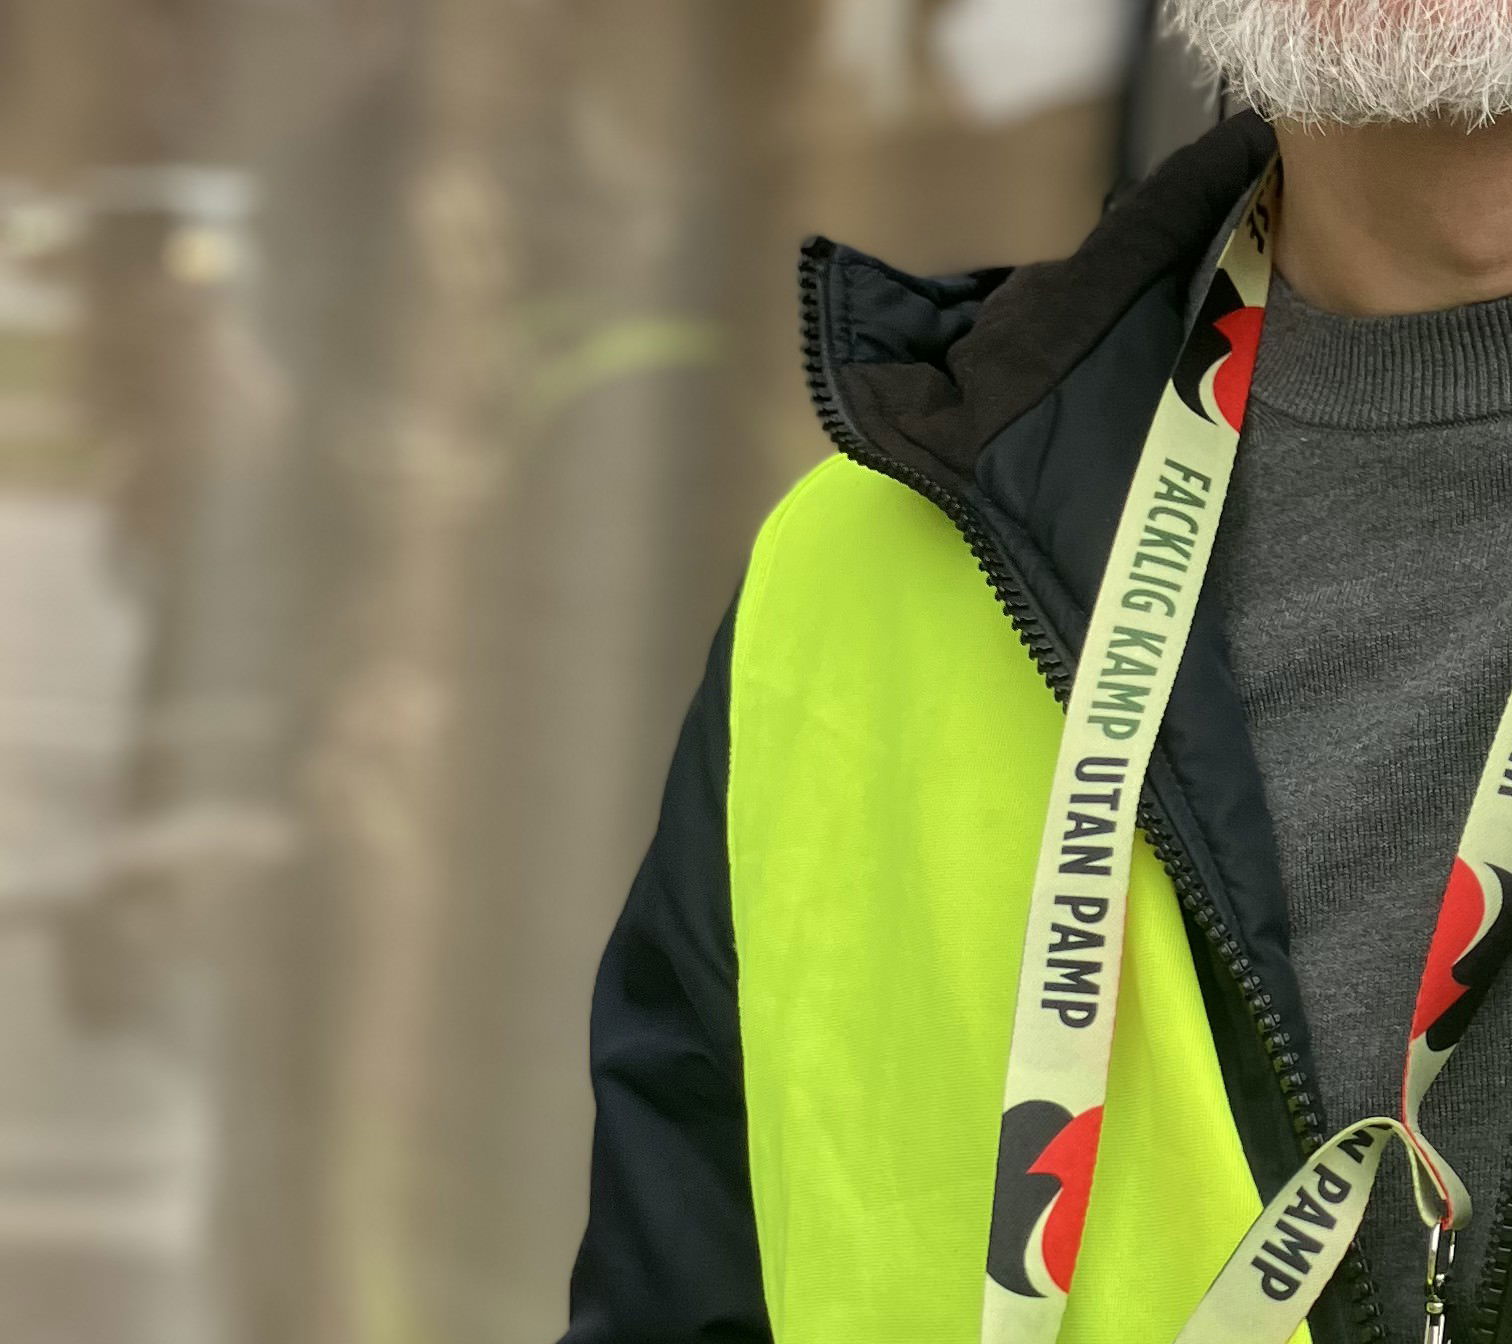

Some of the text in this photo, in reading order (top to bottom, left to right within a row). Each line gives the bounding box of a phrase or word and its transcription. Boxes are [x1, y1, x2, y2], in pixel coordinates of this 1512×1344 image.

[1040, 457, 1211, 1030] FACKLIG KAMP UTAN PAMP
[1249, 1162, 1353, 1303] PAMP
